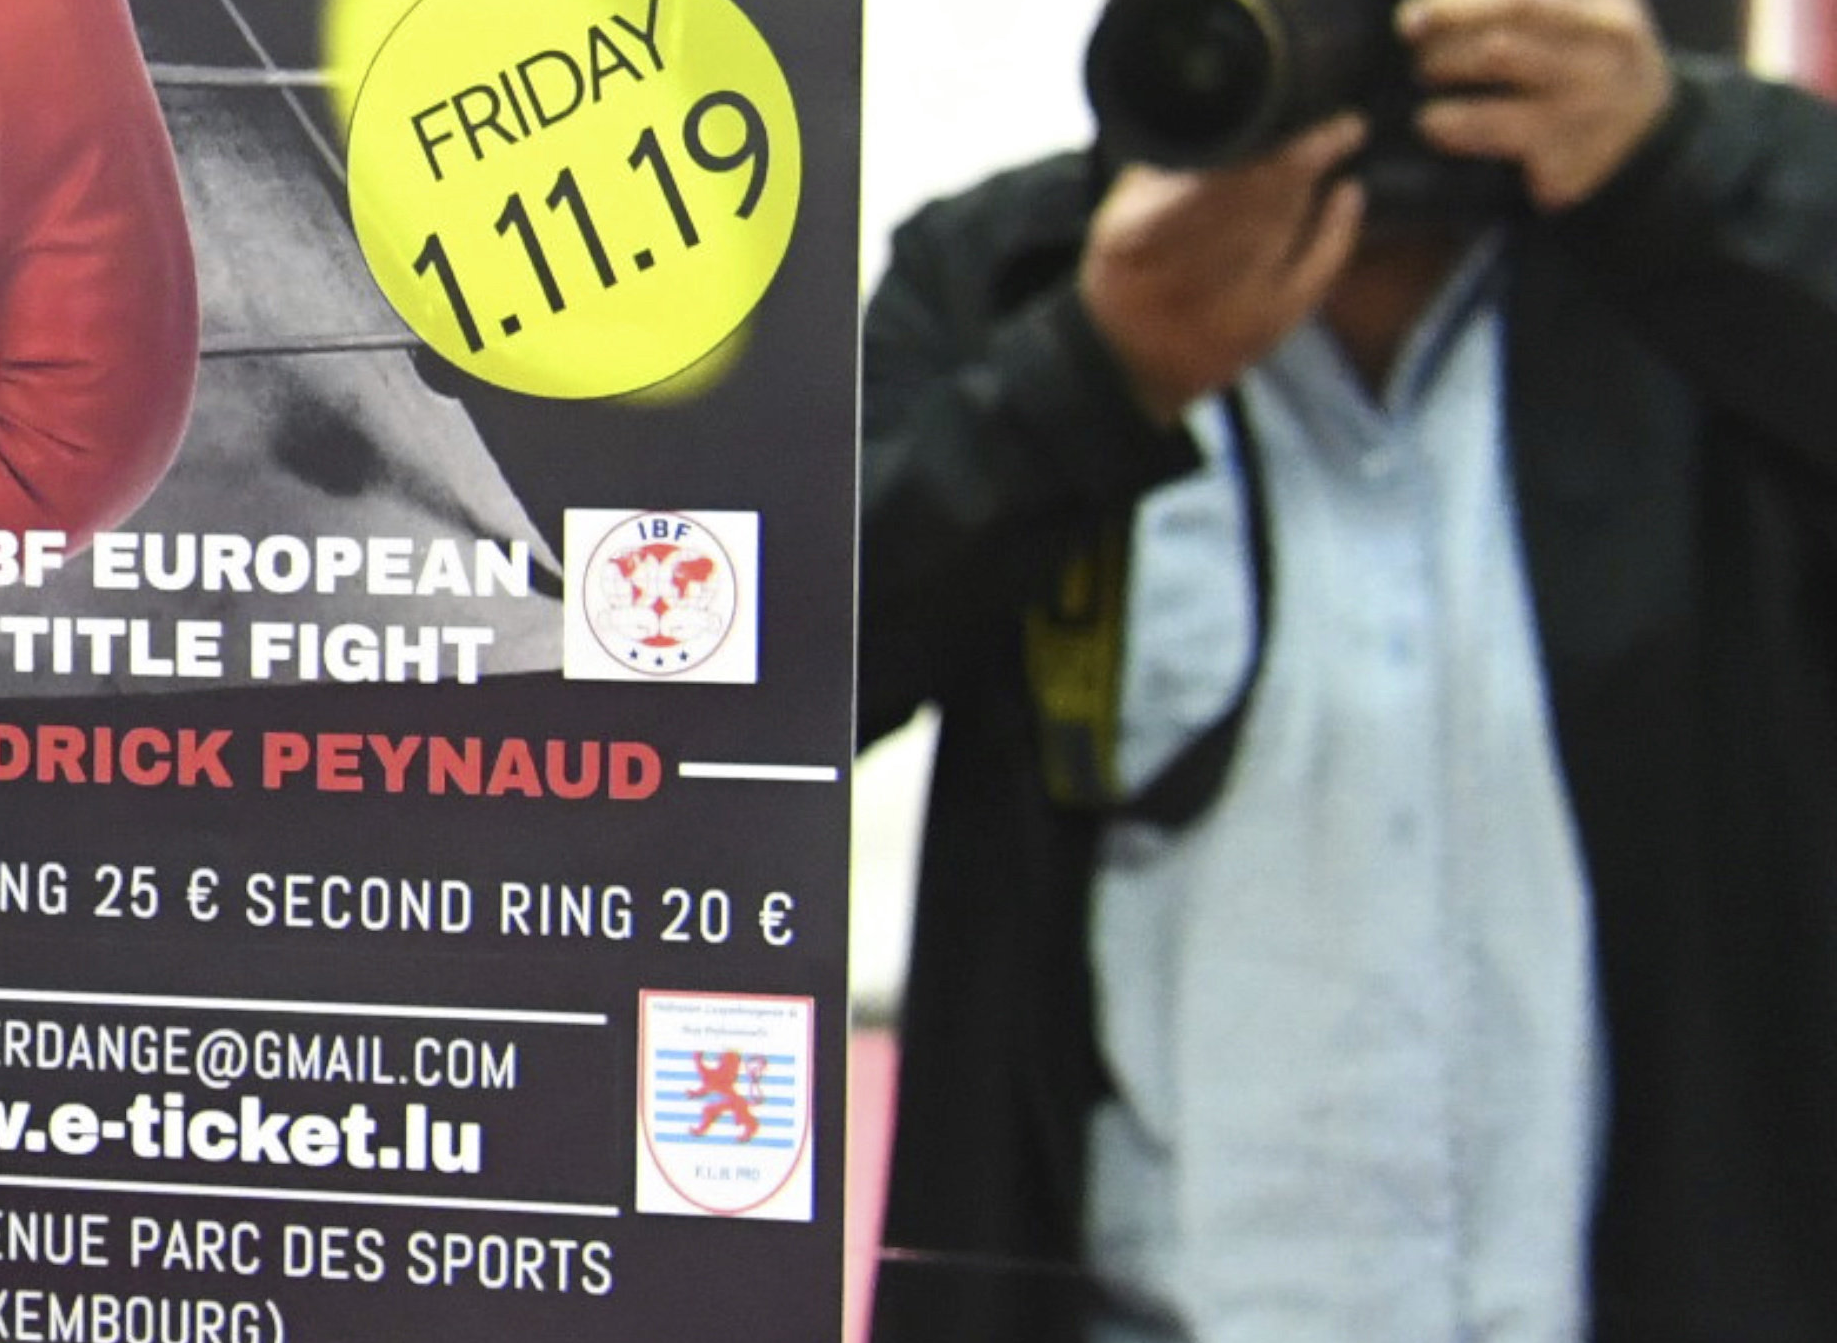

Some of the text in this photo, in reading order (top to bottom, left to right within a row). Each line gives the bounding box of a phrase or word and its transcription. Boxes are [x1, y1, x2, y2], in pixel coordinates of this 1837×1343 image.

[413, 90, 770, 354] 1.11.19
[91, 532, 530, 598] EUROPEAN
[638, 518, 692, 541] IBF
[249, 620, 495, 684] FIGHT
[261, 730, 663, 801] PEYNAUD
[93, 866, 160, 920] 25
[185, 868, 220, 920] €
[243, 876, 473, 934] SECOND
[500, 884, 633, 939] RING
[660, 888, 731, 943] 20
[758, 892, 795, 945] €
[129, 1218, 262, 1273] PARC
[283, 1225, 387, 1280] DES
[405, 1232, 615, 1294] SPORTS
